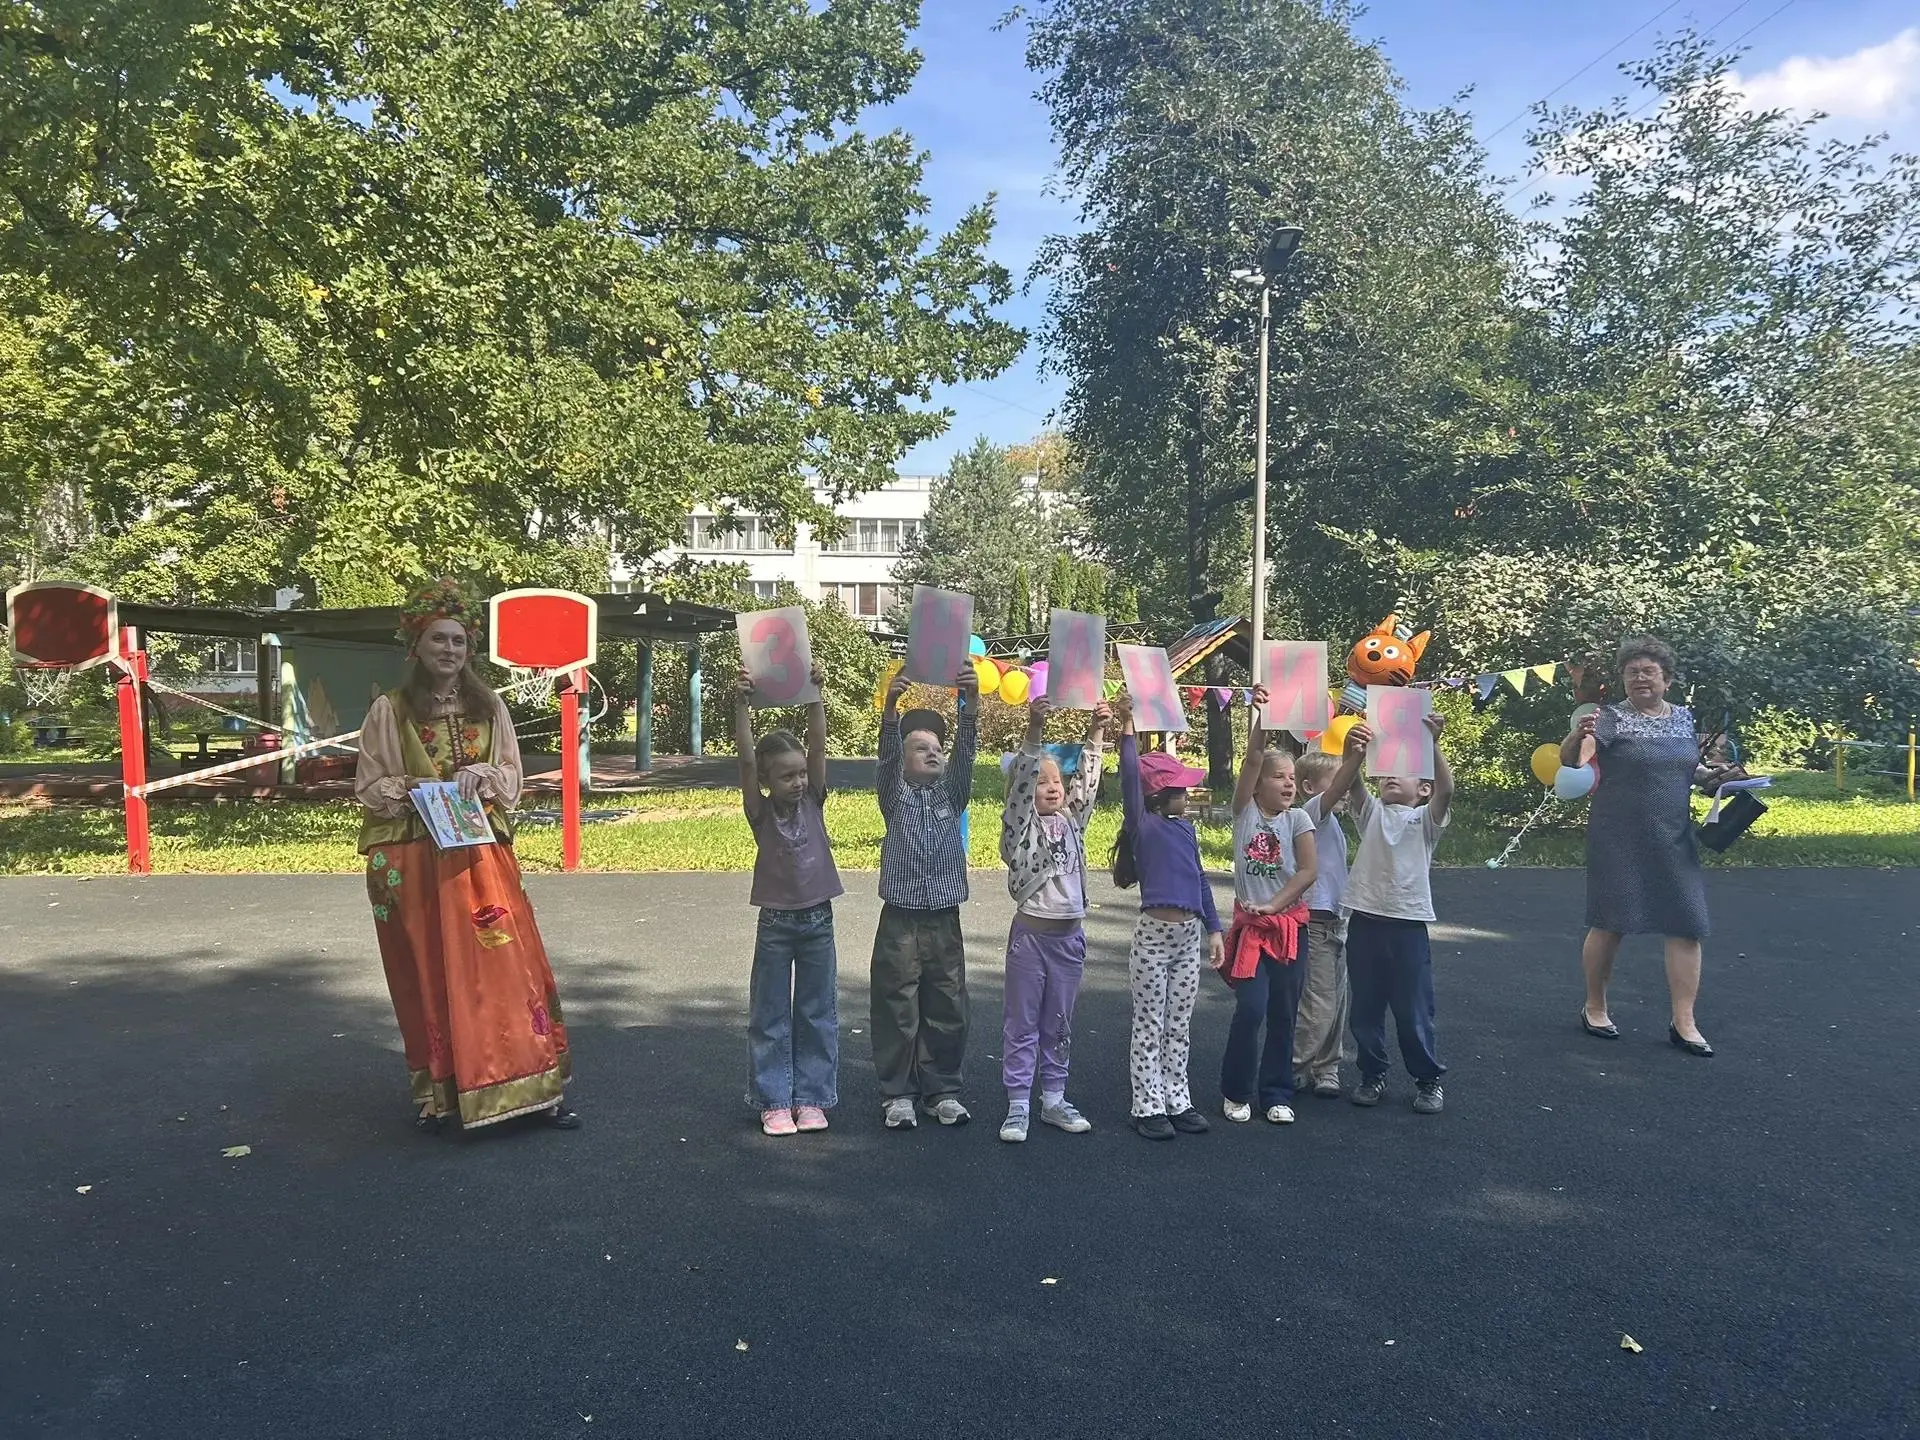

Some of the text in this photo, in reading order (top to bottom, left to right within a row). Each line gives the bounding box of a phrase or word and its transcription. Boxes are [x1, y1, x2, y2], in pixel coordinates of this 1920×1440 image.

[750, 616, 805, 699] З
[917, 593, 966, 681] Н
[1056, 618, 1098, 703] А
[1269, 647, 1318, 724] И
[1376, 691, 1423, 773] Я
[1246, 863, 1277, 880] LOVE
